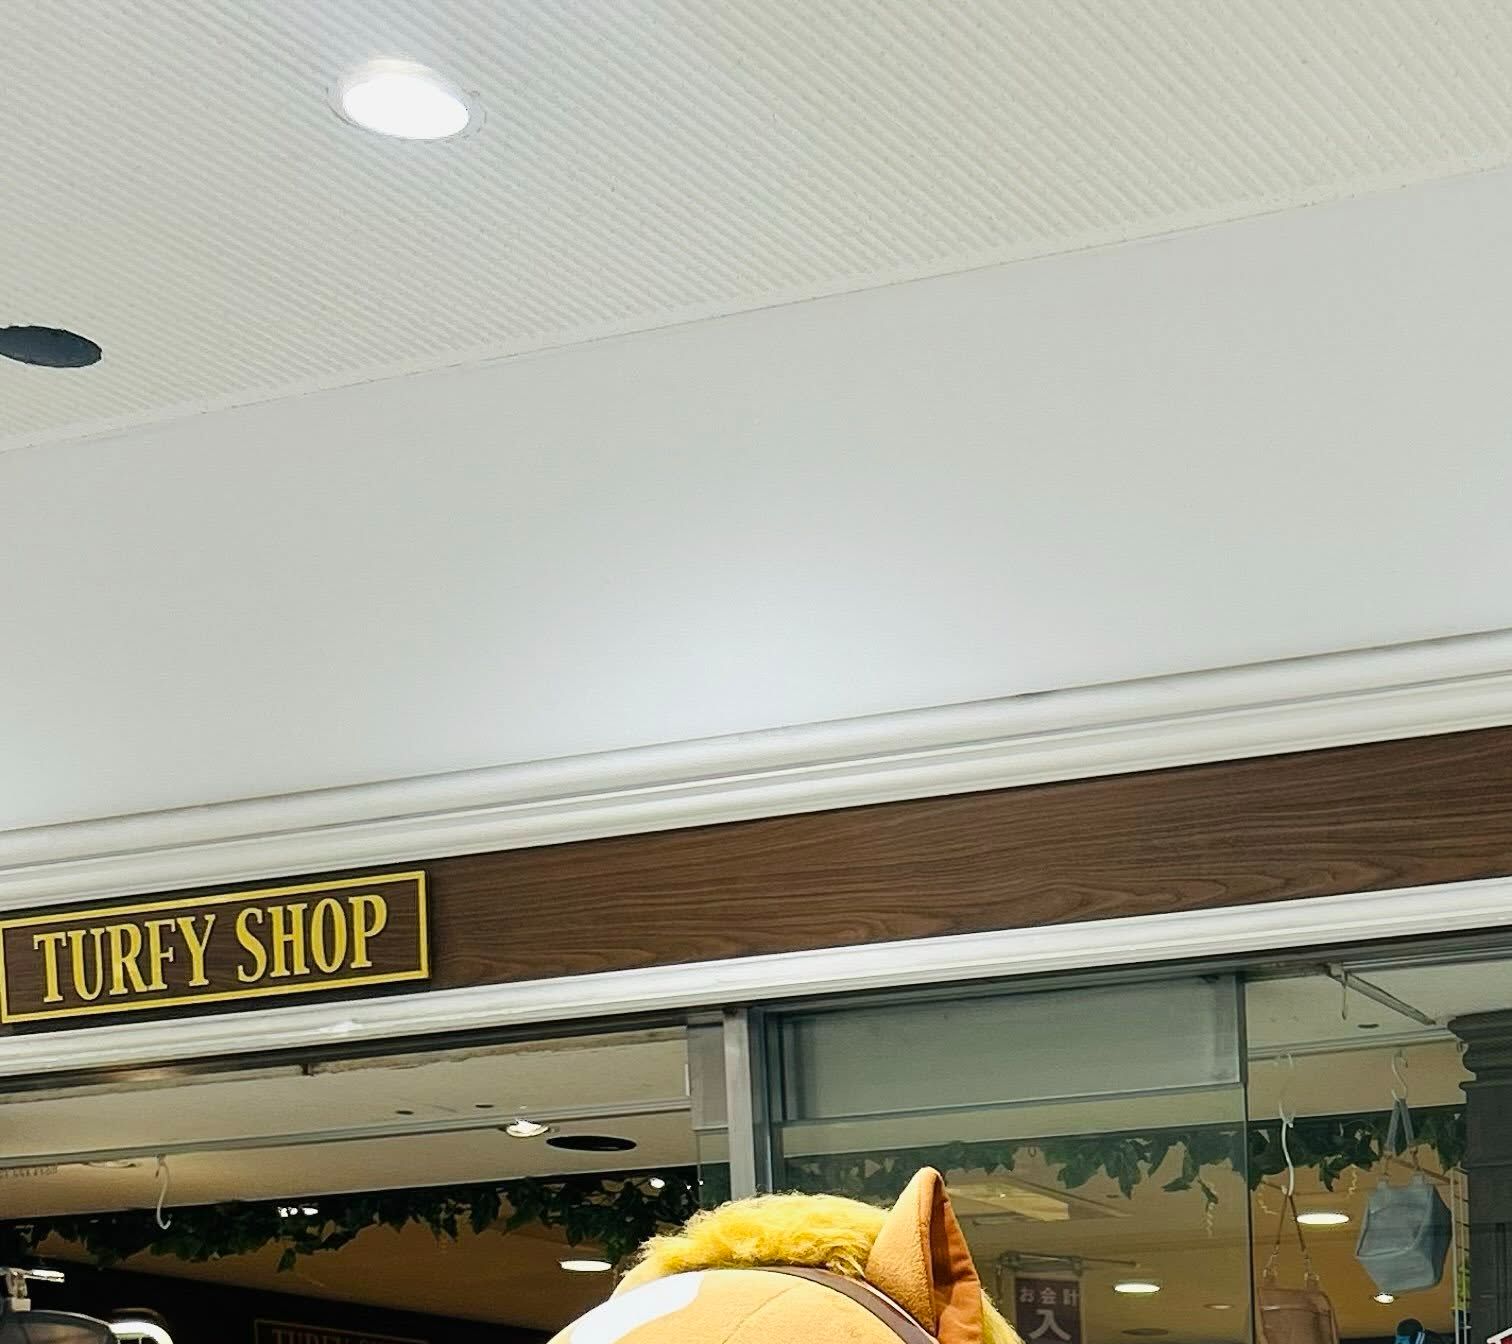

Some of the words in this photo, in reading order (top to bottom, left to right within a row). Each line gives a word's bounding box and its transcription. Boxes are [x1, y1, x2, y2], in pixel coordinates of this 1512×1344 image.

[33, 912, 216, 1004] TURFY
[235, 893, 389, 984] SHOP
[1018, 1287, 1079, 1307] お会計
